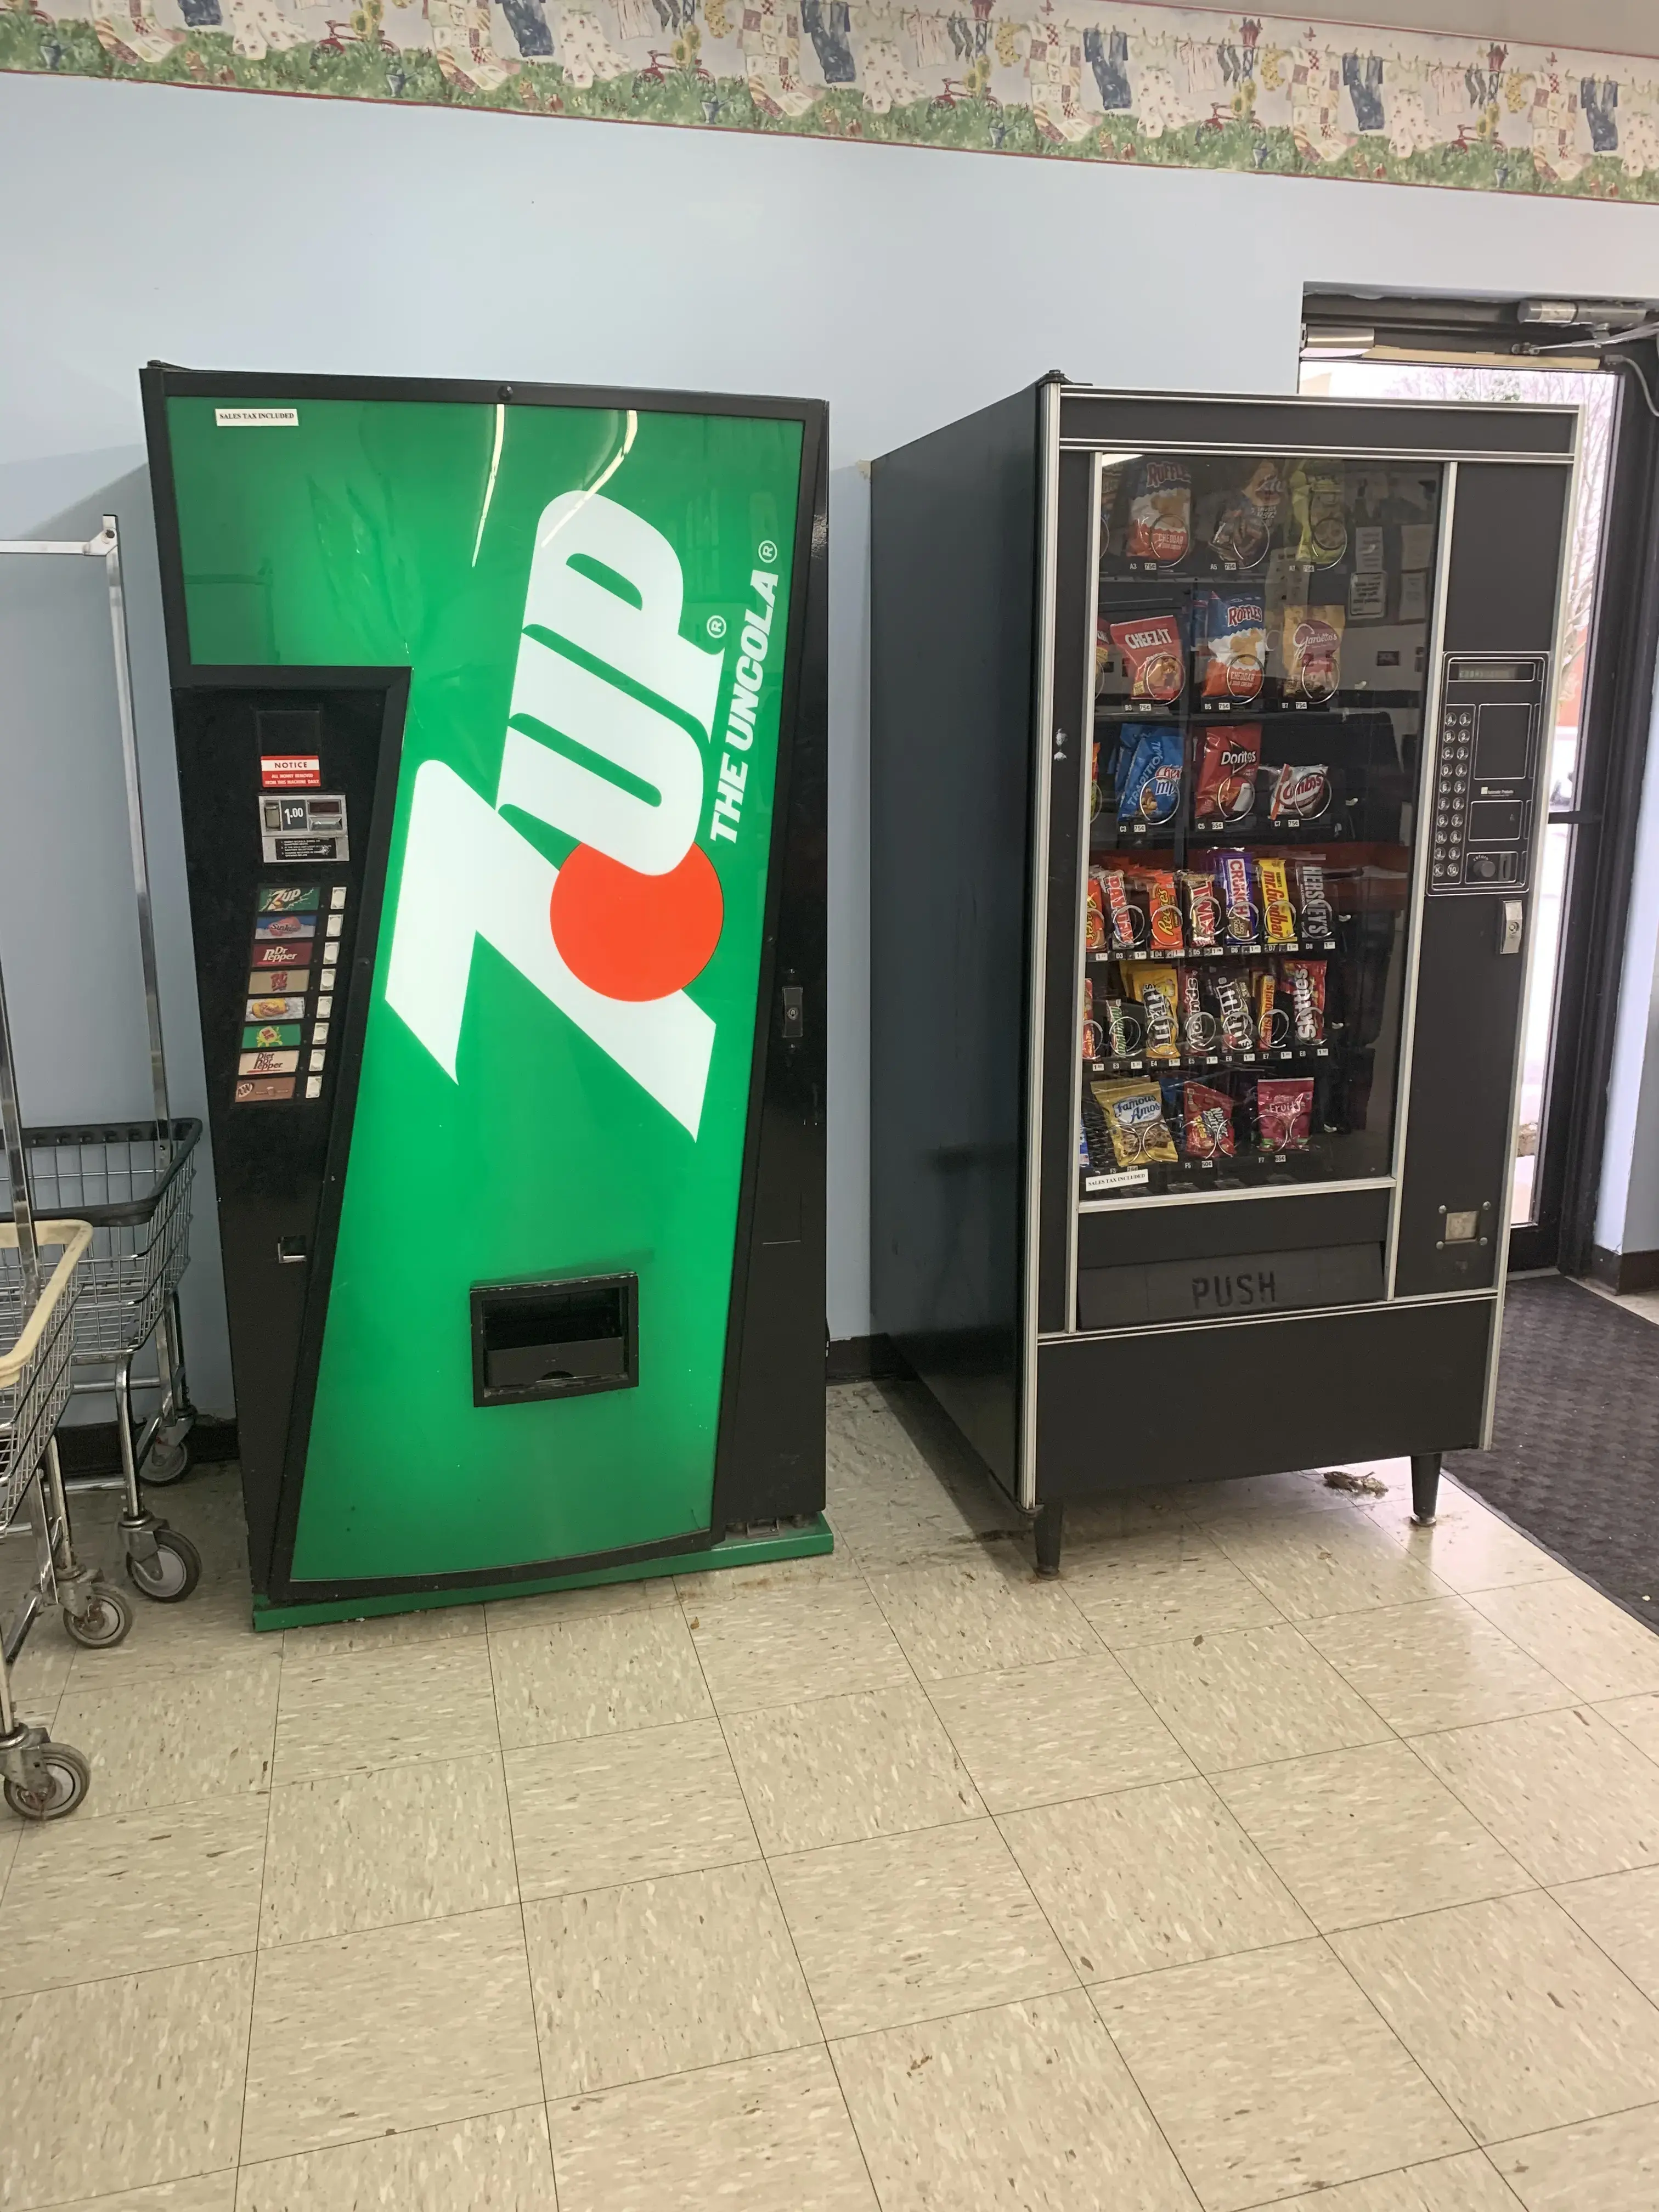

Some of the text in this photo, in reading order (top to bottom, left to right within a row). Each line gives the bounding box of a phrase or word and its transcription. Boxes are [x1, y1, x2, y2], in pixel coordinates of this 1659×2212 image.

[1227, 605, 1262, 627] RUFFLES
[1293, 623, 1338, 661] Gardetto's
[1231, 671, 1255, 682] CHEDDAR
[710, 573, 779, 844] THE UNCOLA
[1221, 751, 1256, 765] Doritos
[285, 808, 303, 825] 1.00
[385, 490, 724, 1143] 7UP
[1229, 860, 1249, 916] CRUNCH
[1303, 866, 1328, 934] HERSHEY'S
[1158, 888, 1174, 936] Reese's
[1193, 880, 1216, 935] TWIX
[263, 949, 297, 962] Pepper
[1294, 968, 1317, 1039] Skttles
[253, 1059, 283, 1069] Pepper
[1113, 1094, 1156, 1118] Famous
[1130, 1103, 1160, 1124] Amos
[1211, 1107, 1228, 1137] Nutter
[1118, 1173, 1146, 1182] INCLUDED
[1192, 1270, 1275, 1310] PUSH
